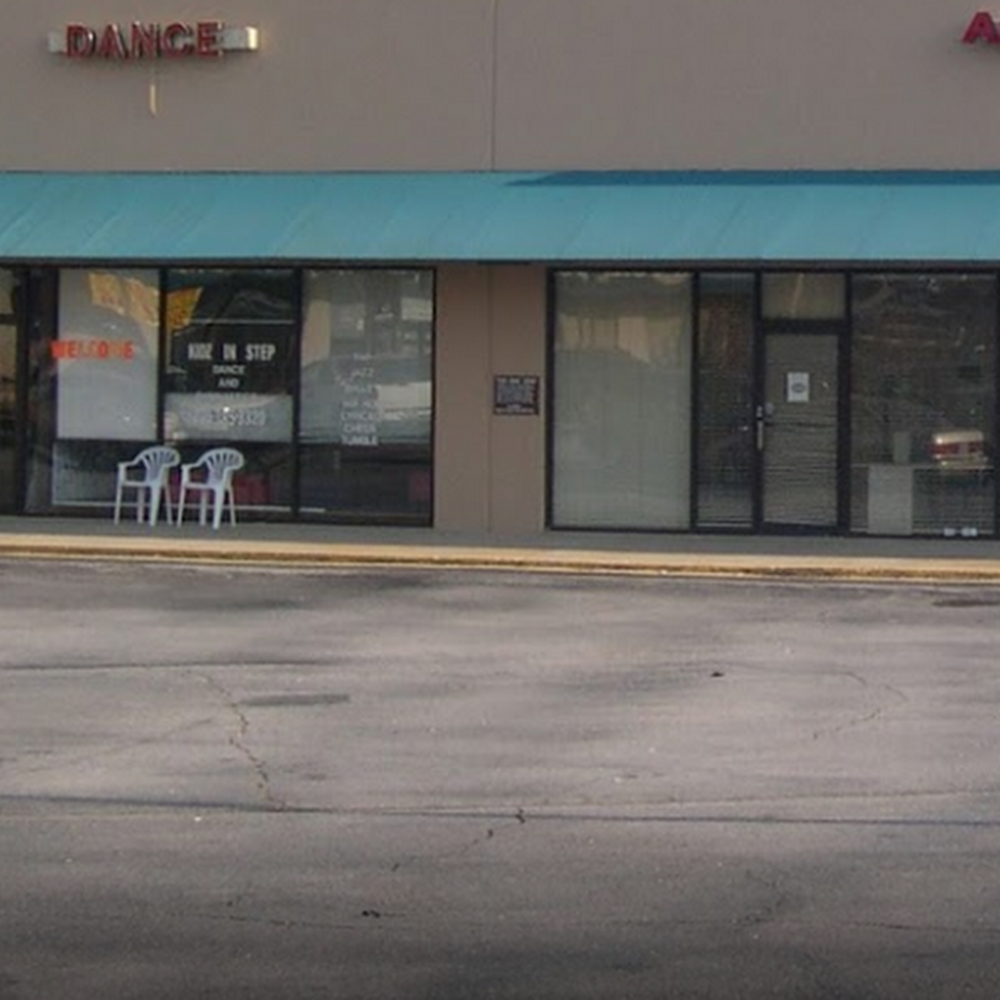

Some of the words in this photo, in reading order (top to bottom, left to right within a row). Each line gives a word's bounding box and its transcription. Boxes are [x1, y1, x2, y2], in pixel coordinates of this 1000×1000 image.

[66, 22, 221, 58] DANCE
[223, 343, 237, 360] IN
[245, 343, 276, 361] STEP
[212, 364, 245, 375] DANCE
[218, 378, 239, 389] AND
